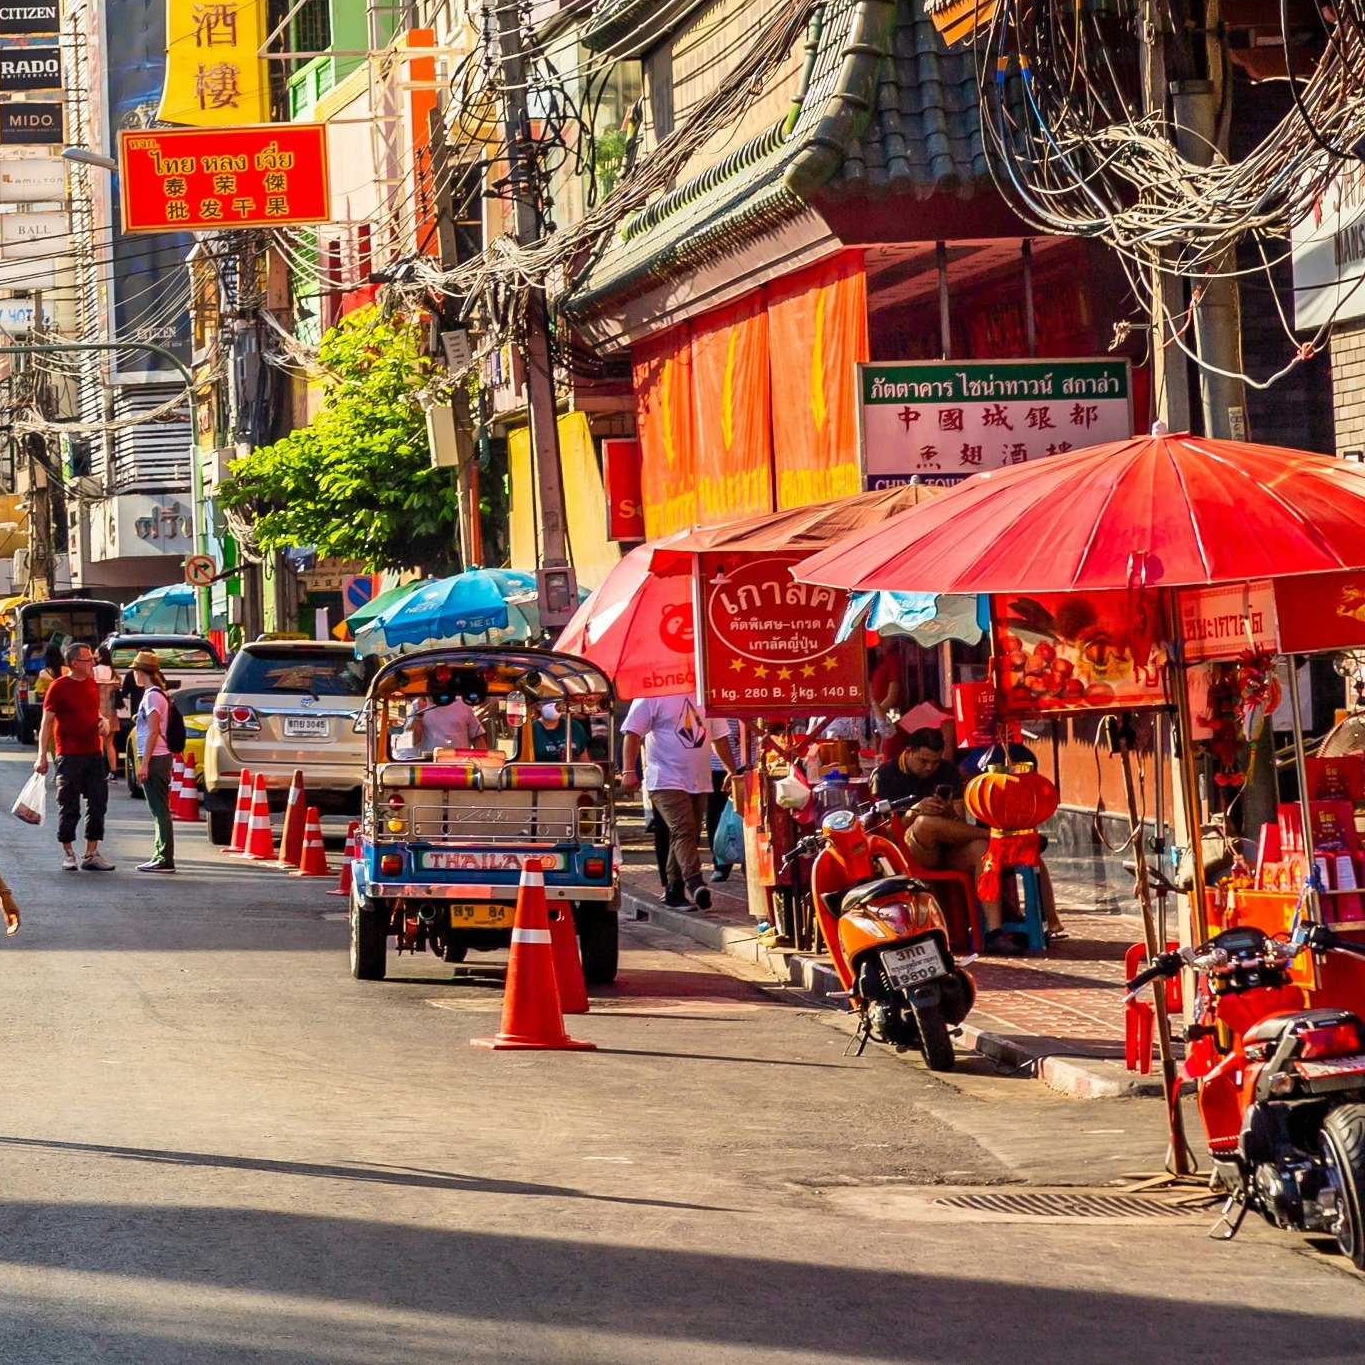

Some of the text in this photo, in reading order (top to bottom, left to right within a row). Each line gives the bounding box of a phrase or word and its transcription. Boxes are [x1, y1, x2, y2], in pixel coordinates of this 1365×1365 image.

[0, 7, 56, 20] CITIZEN
[1, 60, 59, 75] RADO
[9, 115, 53, 127] MIDO
[150, 149, 195, 174] ไทย
[202, 155, 247, 172] หลง
[19, 225, 51, 235] BALL
[957, 372, 1053, 396] ไชน่าทาวน์
[1062, 371, 1120, 394] สกาล่า
[897, 402, 1099, 433] 中國城銀都
[875, 478, 920, 492] CHIN
[827, 619, 836, 628] A
[711, 688, 716, 698] 1
[722, 687, 740, 701] kg.
[744, 688, 768, 698] 280
[773, 688, 786, 698] B.
[799, 687, 817, 700] kg.
[822, 686, 844, 697] 140
[849, 686, 862, 697] B.
[430, 852, 557, 869] THAILAD
